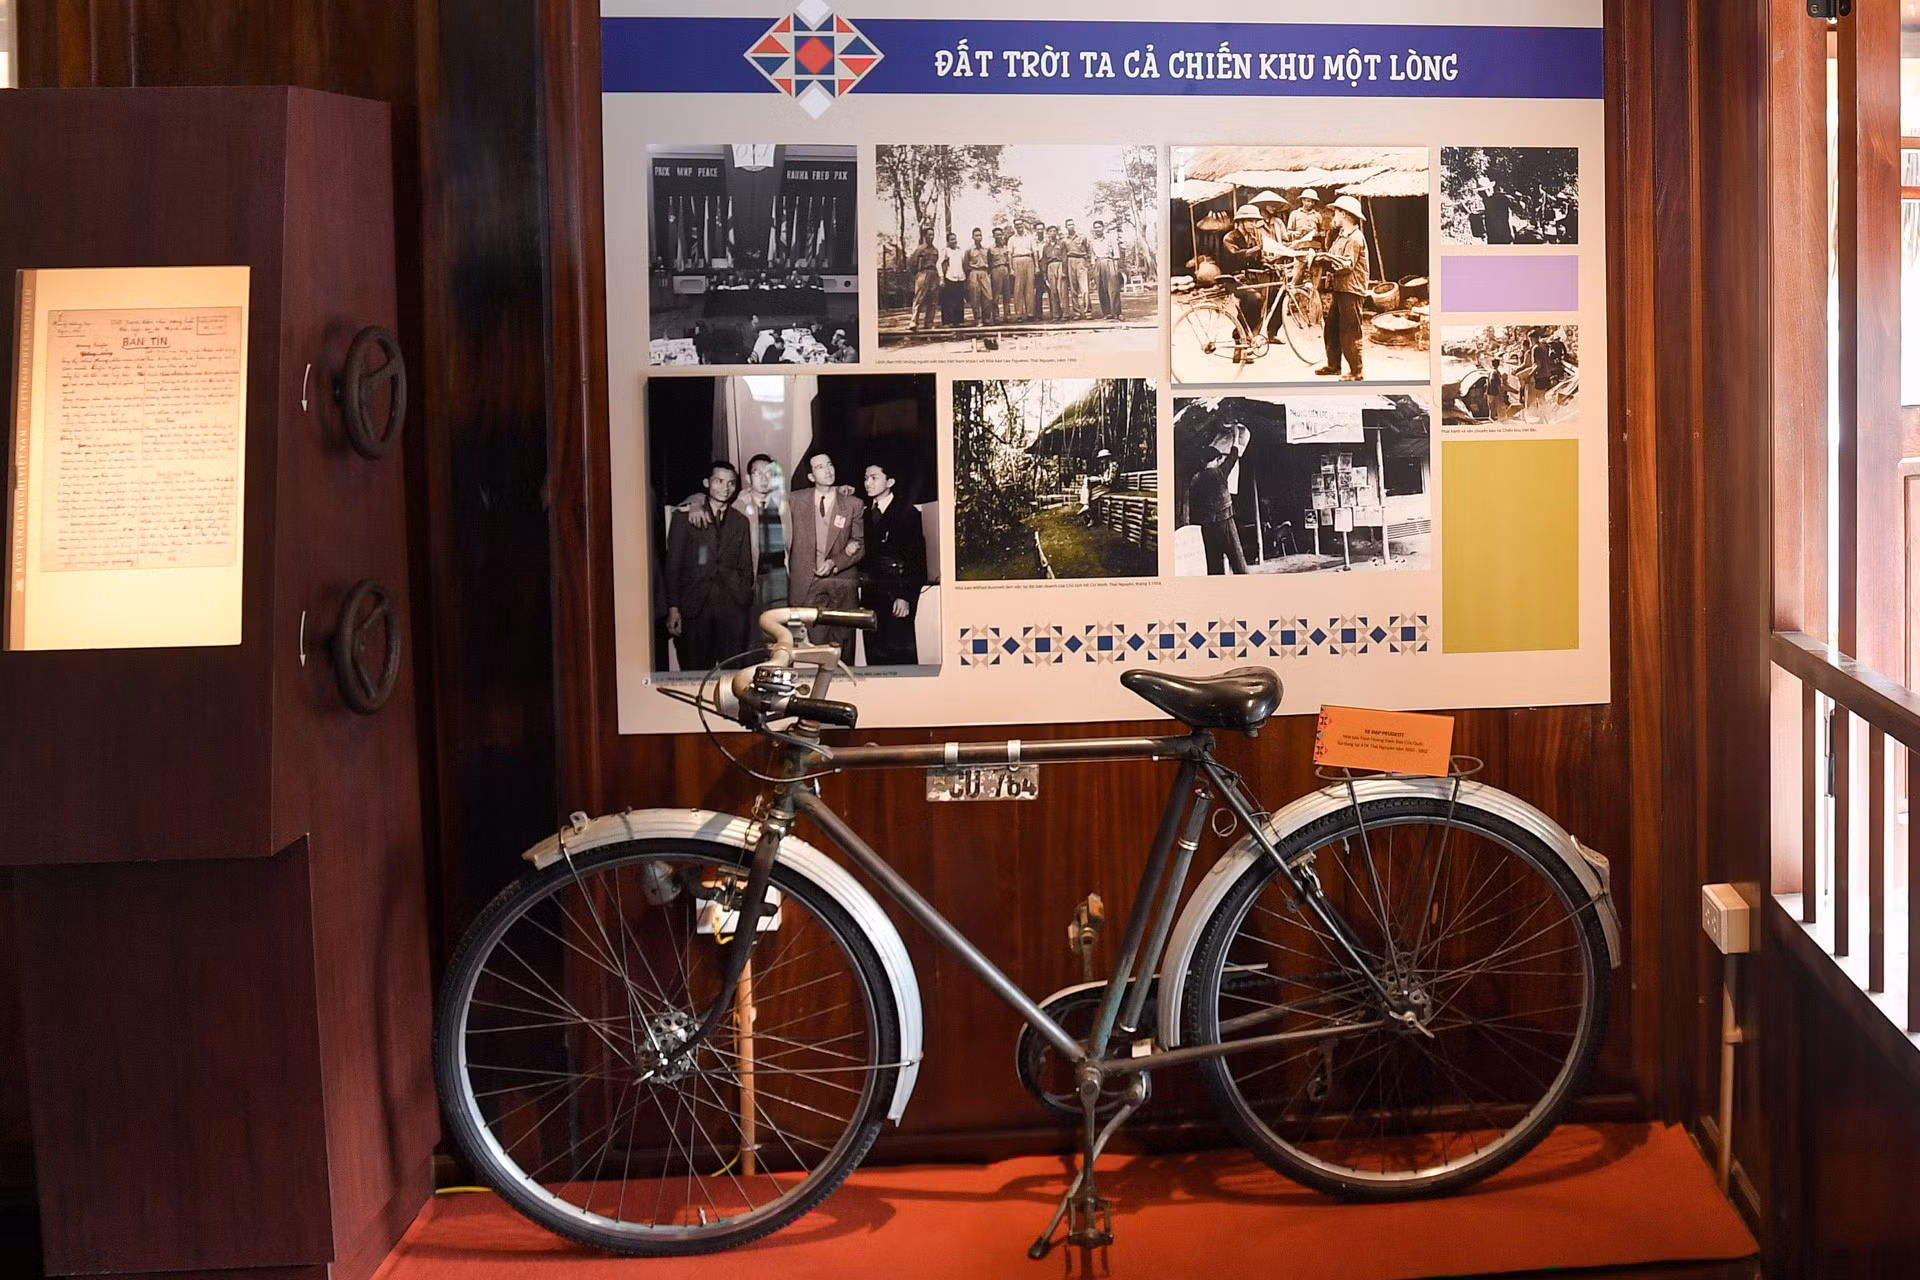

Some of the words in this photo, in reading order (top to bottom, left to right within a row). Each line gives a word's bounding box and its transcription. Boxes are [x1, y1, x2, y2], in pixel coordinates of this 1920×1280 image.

[934, 38, 993, 78] ĐẤT
[1003, 44, 1070, 78] TRỜI
[1080, 51, 1115, 78] TA
[1123, 44, 1160, 79] CẢ
[1168, 41, 1252, 80] CHIẾN
[1259, 53, 1315, 80] KHU
[1323, 48, 1381, 87] MỘT
[1390, 48, 1458, 81] LÒNG
[834, 171, 848, 181] PAX
